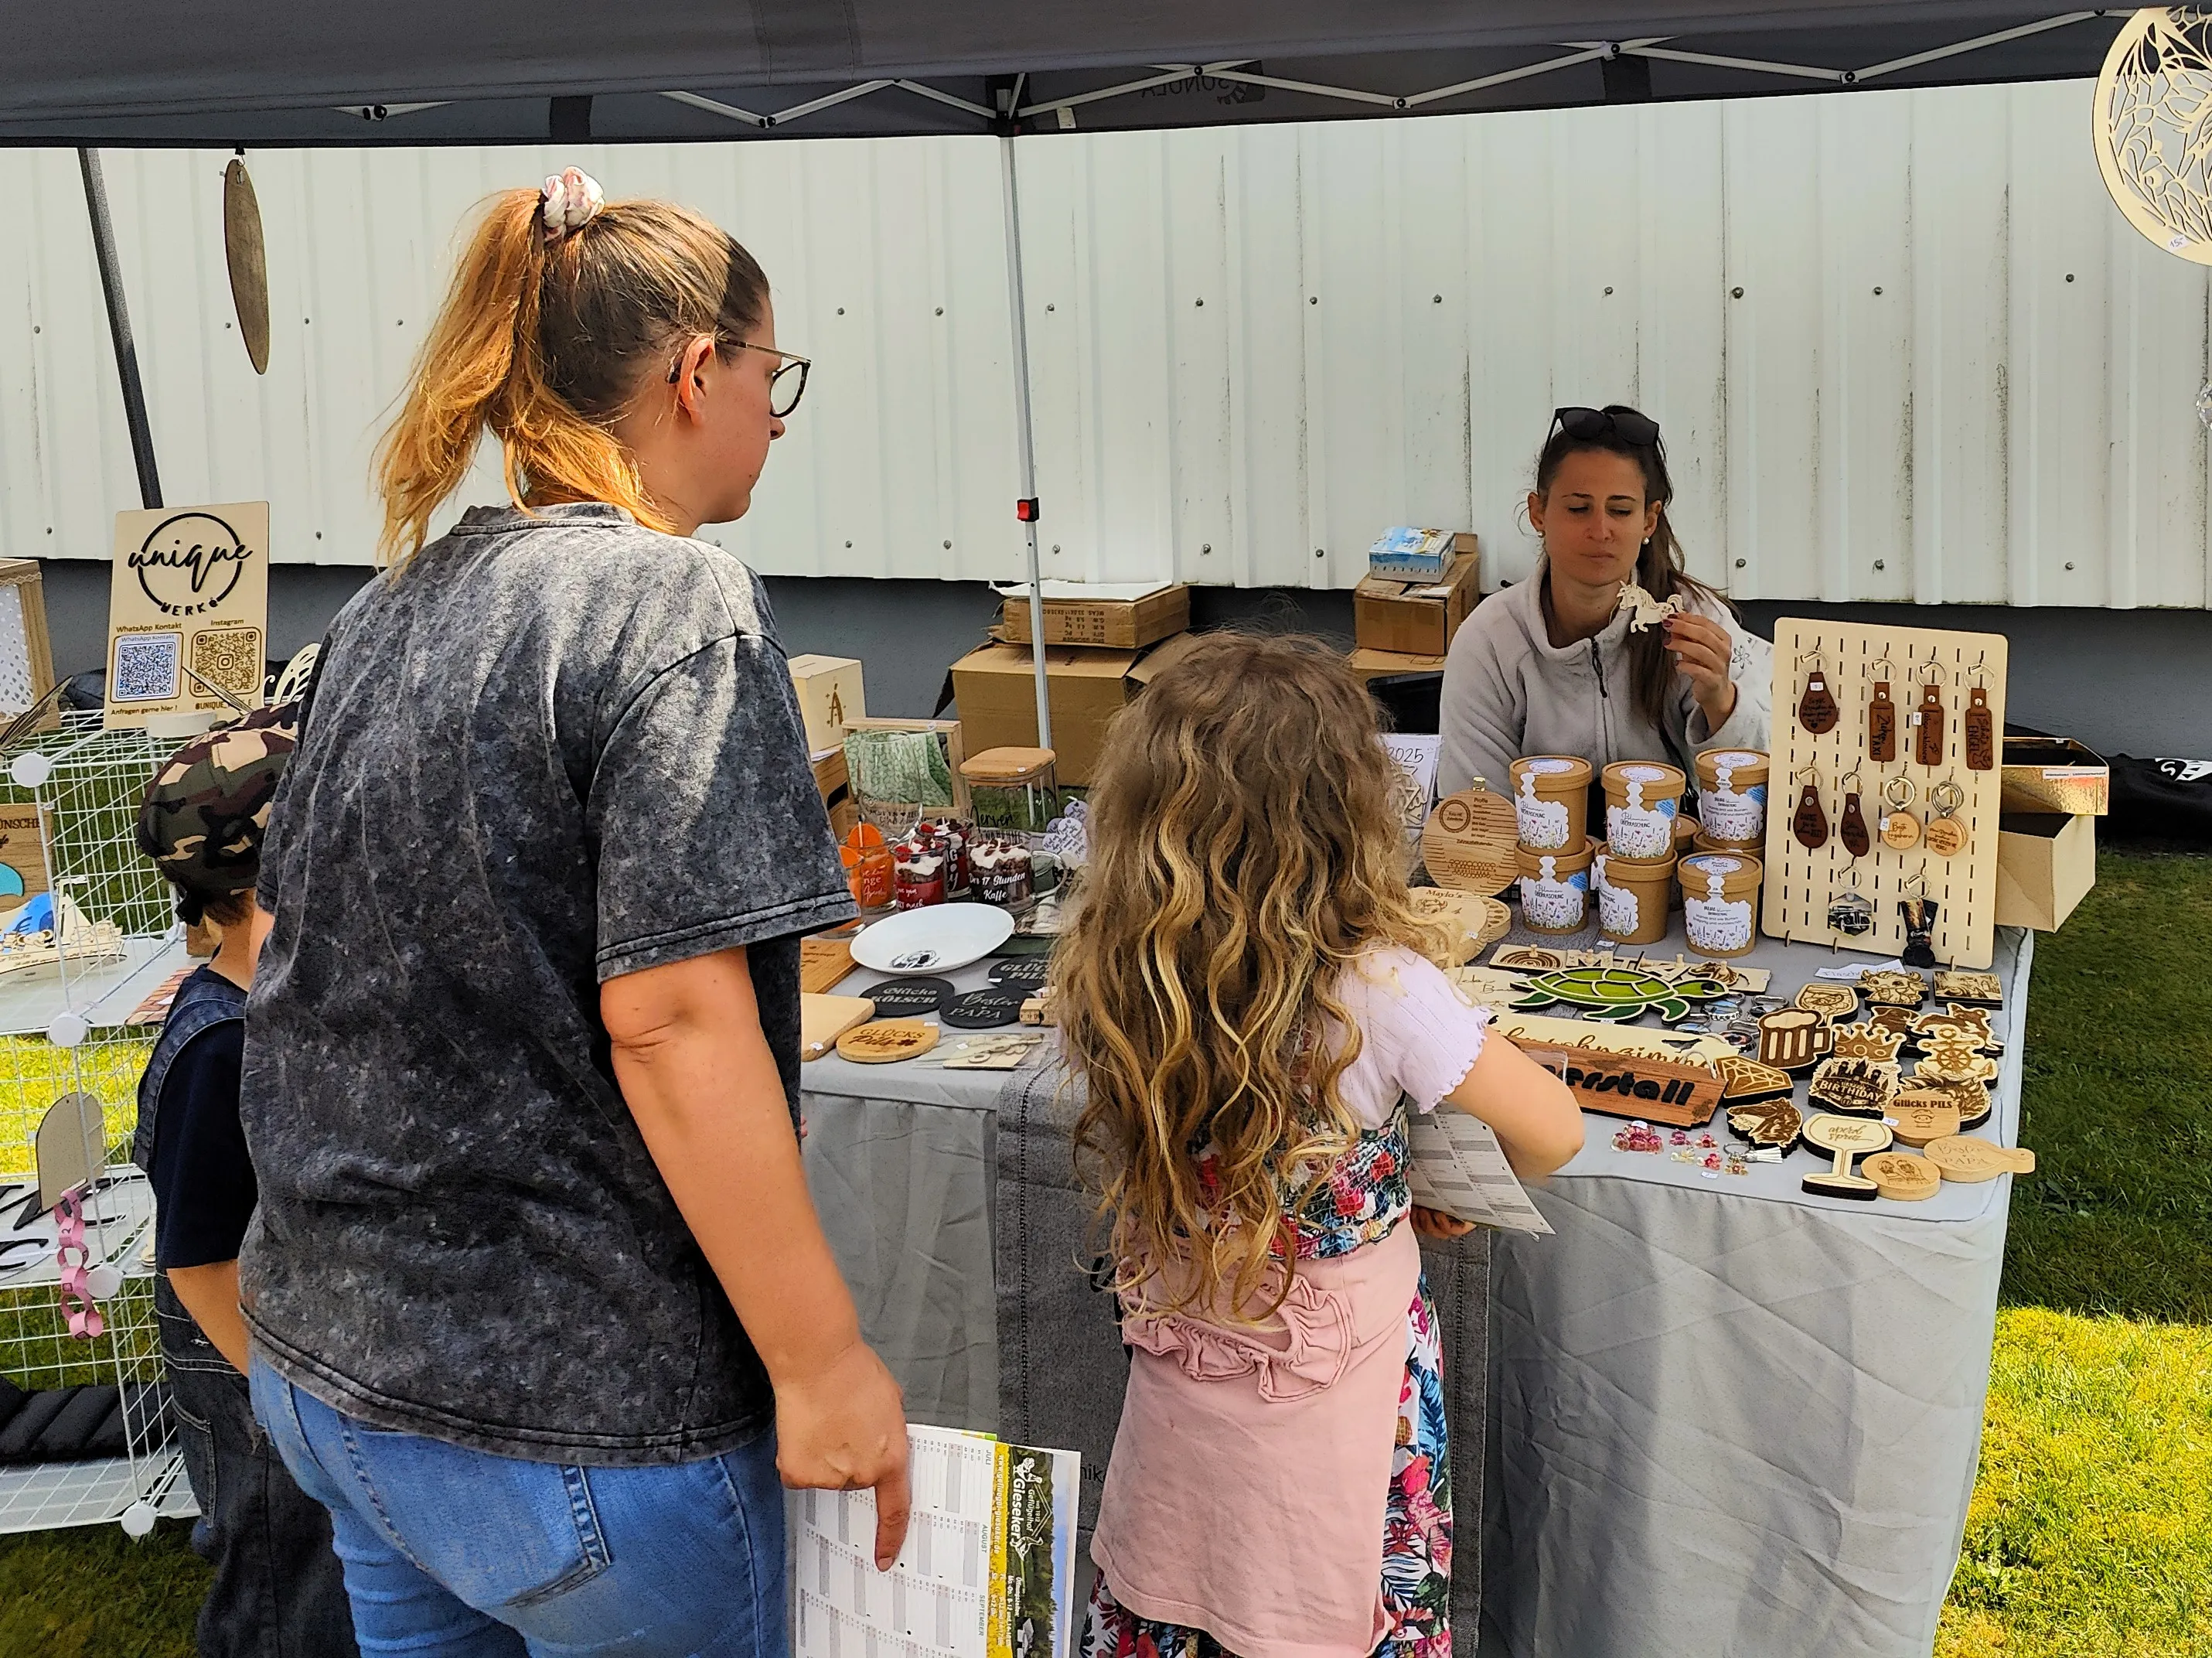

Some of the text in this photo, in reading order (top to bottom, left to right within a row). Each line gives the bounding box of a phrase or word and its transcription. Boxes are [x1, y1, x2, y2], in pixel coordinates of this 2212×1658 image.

[128, 539, 254, 593] unique
[116, 622, 182, 633] WhatsApp Kontakt
[210, 618, 244, 626] Instagram
[141, 707, 159, 715] gerne
[1870, 735, 1882, 756] TAXI
[1968, 725, 1979, 753] ENGEL
[1389, 746, 1424, 763] 2025
[981, 876, 990, 885] 17
[993, 872, 1026, 886] Stunden
[1426, 889, 1463, 899] Maylo's
[871, 994, 939, 1005] KÖLSCH
[962, 992, 1021, 1007] Bester
[948, 1007, 1001, 1019] PAPA
[860, 1027, 925, 1039] GLÜCKS
[1542, 1064, 1695, 1106] erstall
[1818, 1080, 1886, 1102] BIRTHDAY
[1893, 1099, 1952, 1109] Glücks PILS
[1011, 1478, 1026, 1540] Gieseker
[1026, 1489, 1035, 1533] Geflügelhof
